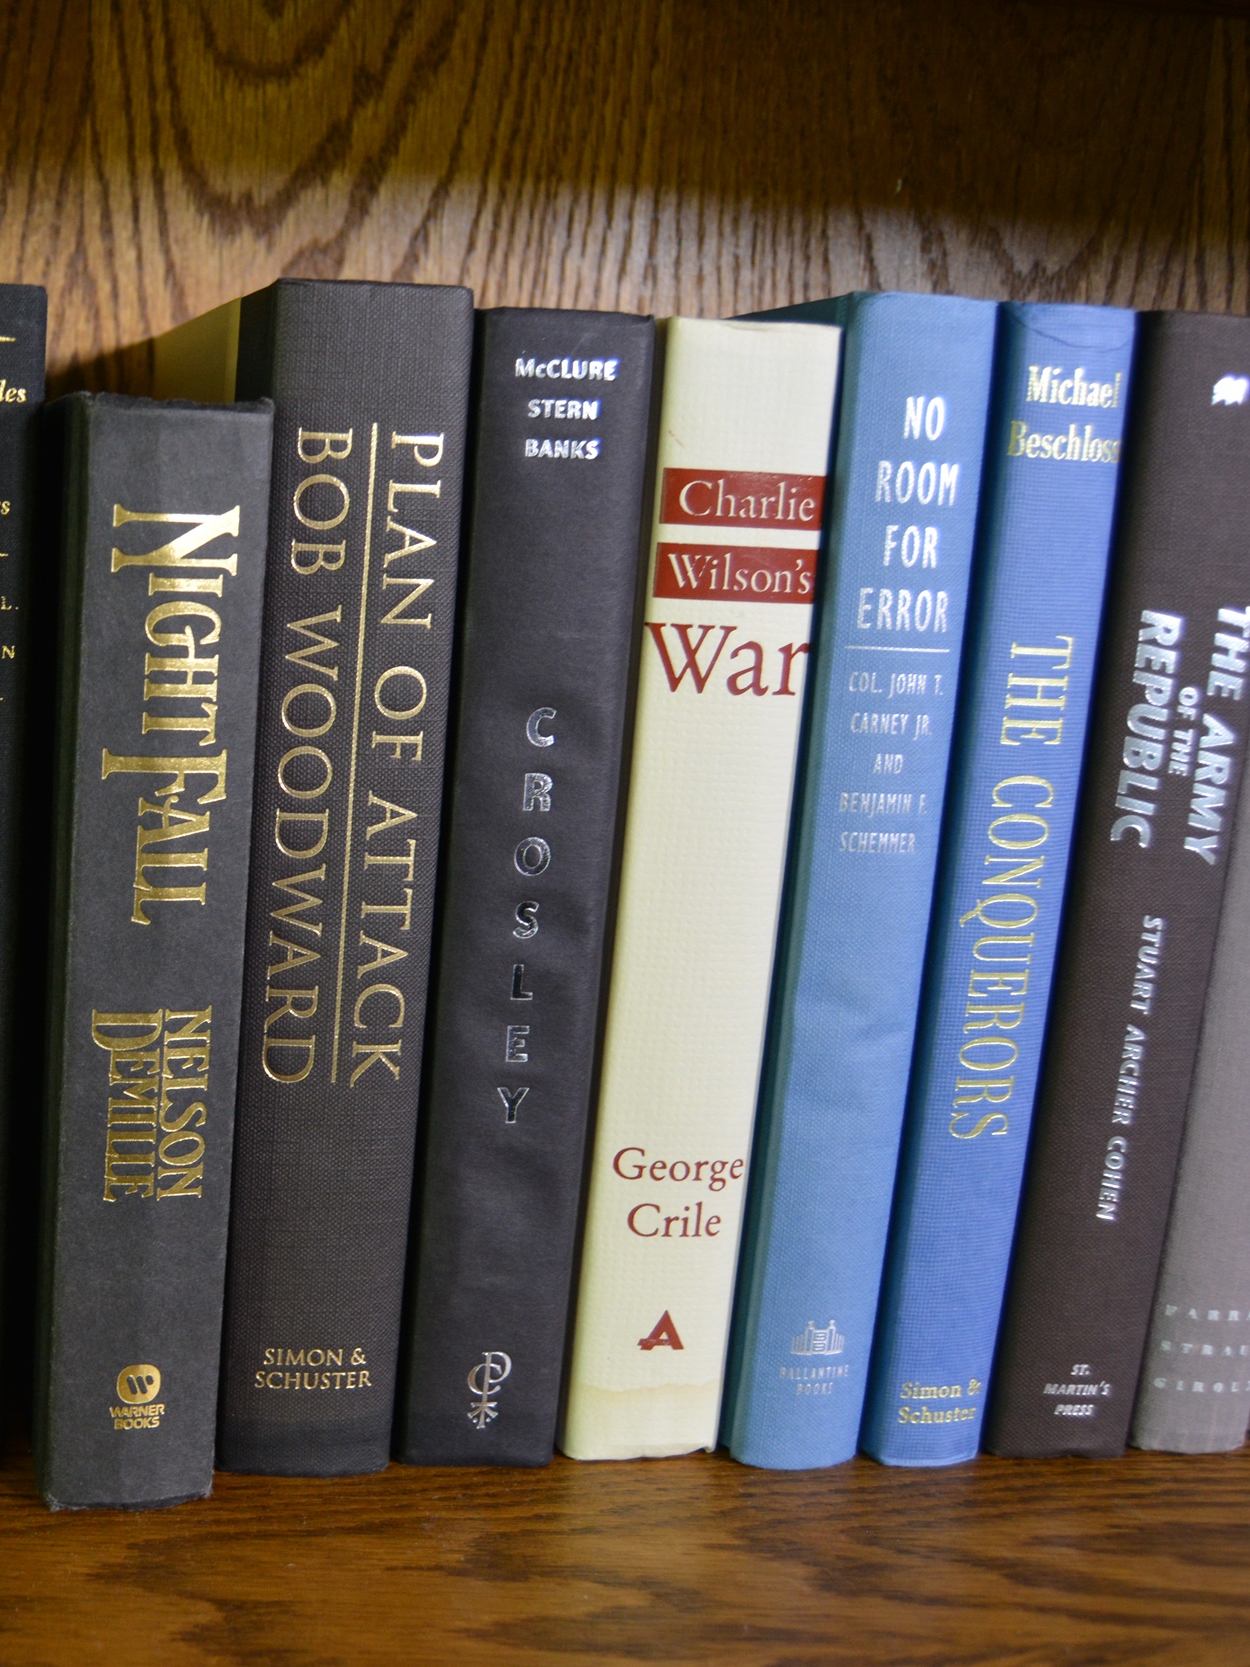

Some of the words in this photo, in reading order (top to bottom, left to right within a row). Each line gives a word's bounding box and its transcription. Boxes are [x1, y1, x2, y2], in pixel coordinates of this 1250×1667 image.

[515, 357, 618, 381] McCLURE
[1026, 365, 1121, 408] Michael
[527, 399, 598, 420] STERN
[903, 396, 945, 441] NO
[524, 438, 599, 460] BANKS
[1007, 420, 1121, 463] Beschloss
[290, 426, 353, 575] BOB
[678, 480, 816, 522] Charlie
[875, 460, 959, 507] ROOM
[382, 431, 444, 630] PLAN
[882, 524, 938, 569] FOR
[667, 553, 812, 596] Wilson's
[1, 596, 20, 611] L.
[857, 586, 949, 634] ERROR
[645, 621, 811, 696] War
[1207, 606, 1250, 700] THE
[849, 671, 882, 694] COL.
[887, 672, 928, 700] JOHN
[934, 674, 944, 696] T.
[999, 635, 1075, 746] THE
[1177, 686, 1199, 721] OF
[372, 666, 428, 762] OF
[851, 712, 909, 735] CARNEY
[1110, 609, 1183, 849] REPUBLIC
[873, 753, 903, 775] AND
[1168, 728, 1193, 777] THE
[839, 792, 912, 819] BENJAMIN
[1184, 713, 1235, 865] ARMY
[262, 604, 343, 1083] WOODWARD
[840, 831, 916, 853] SCHEMMER
[350, 790, 419, 1087] ATTACK
[949, 776, 1054, 1139] CONQUERORS
[1131, 914, 1166, 1016] STUART
[1112, 1023, 1146, 1126] ARCHER
[156, 1005, 213, 1201] NELSON
[612, 1147, 744, 1190] George
[1096, 1135, 1129, 1222] COHEN
[626, 1203, 722, 1239] Crile
[254, 1369, 373, 1389] SCHUSTER
[263, 1348, 345, 1368] SIMON
[350, 1349, 367, 1368] &
[900, 1380, 962, 1400] Simon
[967, 1378, 983, 1395] &
[1043, 1380, 1110, 1396] MARTIN'S
[109, 1403, 165, 1418] WARNER
[114, 1416, 161, 1430] BOOKS
[897, 1406, 976, 1425] Schuster
[1054, 1403, 1094, 1417] PRESS
